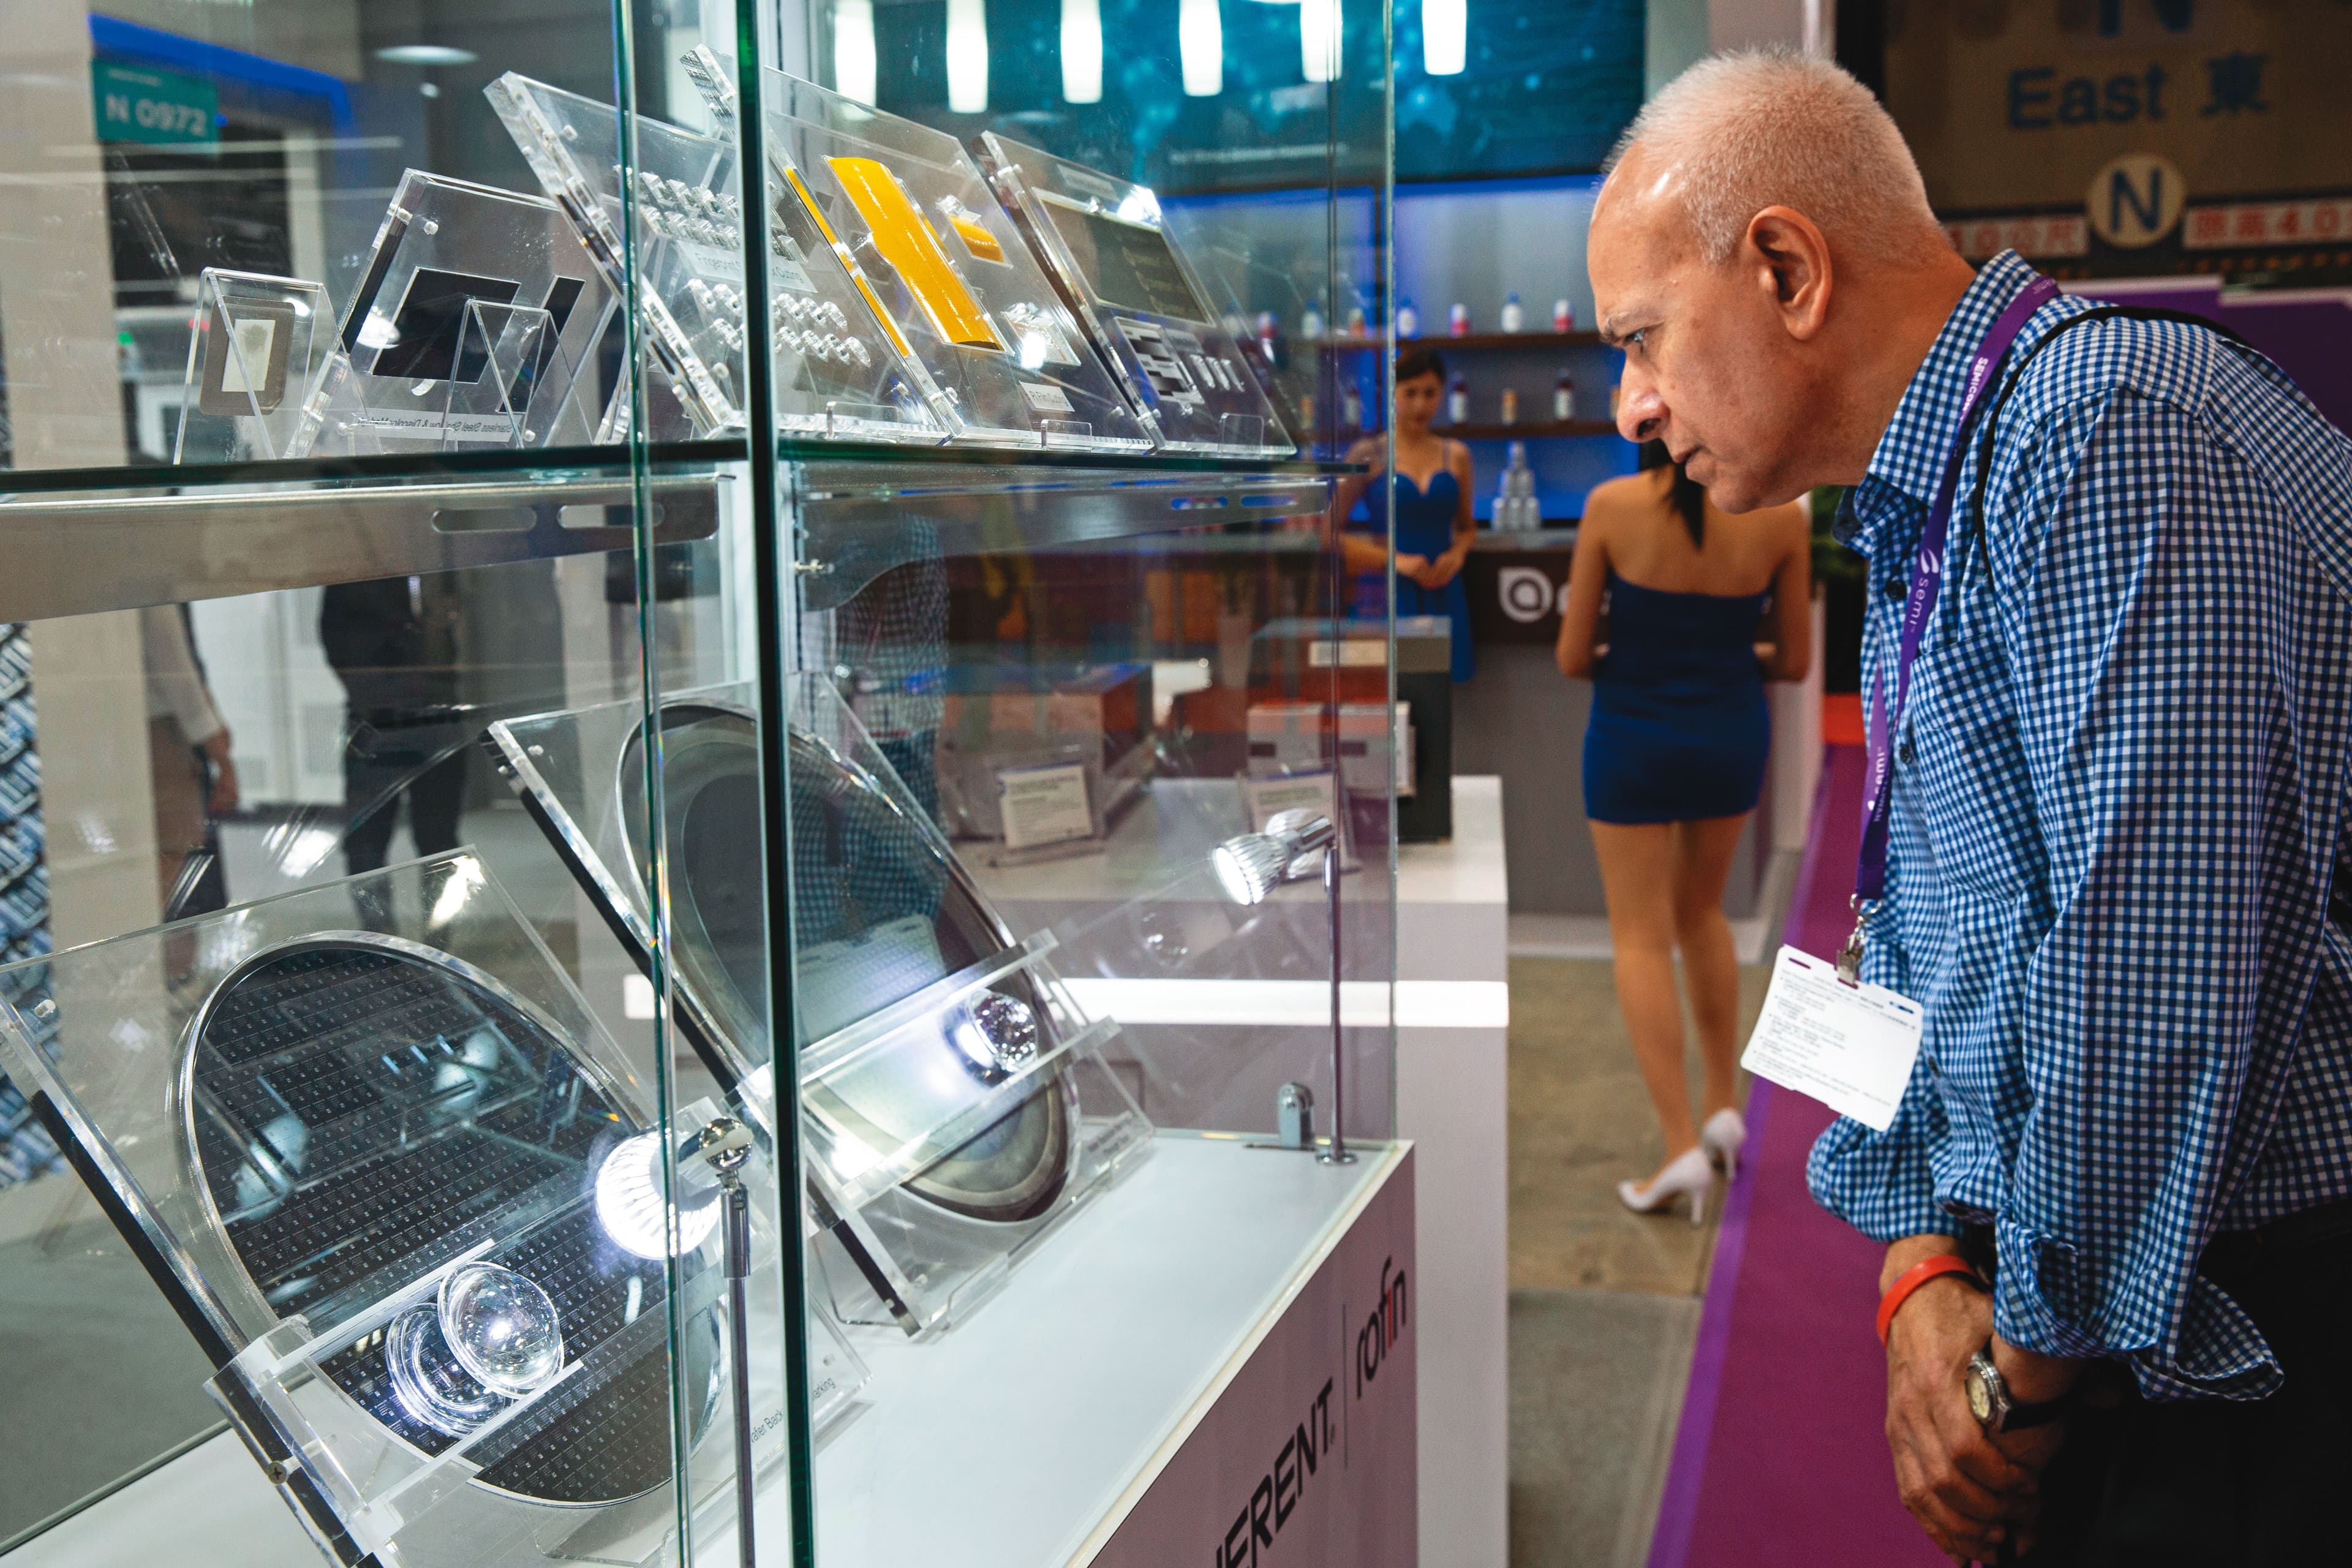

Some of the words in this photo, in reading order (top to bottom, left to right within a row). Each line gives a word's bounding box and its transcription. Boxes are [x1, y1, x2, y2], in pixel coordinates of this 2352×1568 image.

[106, 93, 130, 123] N
[2007, 64, 2166, 128] East
[2201, 51, 2271, 117] 東
[2110, 167, 2162, 233] N
[1356, 1254, 1406, 1401] rofin
[1216, 1376, 1333, 1568] ERENT
